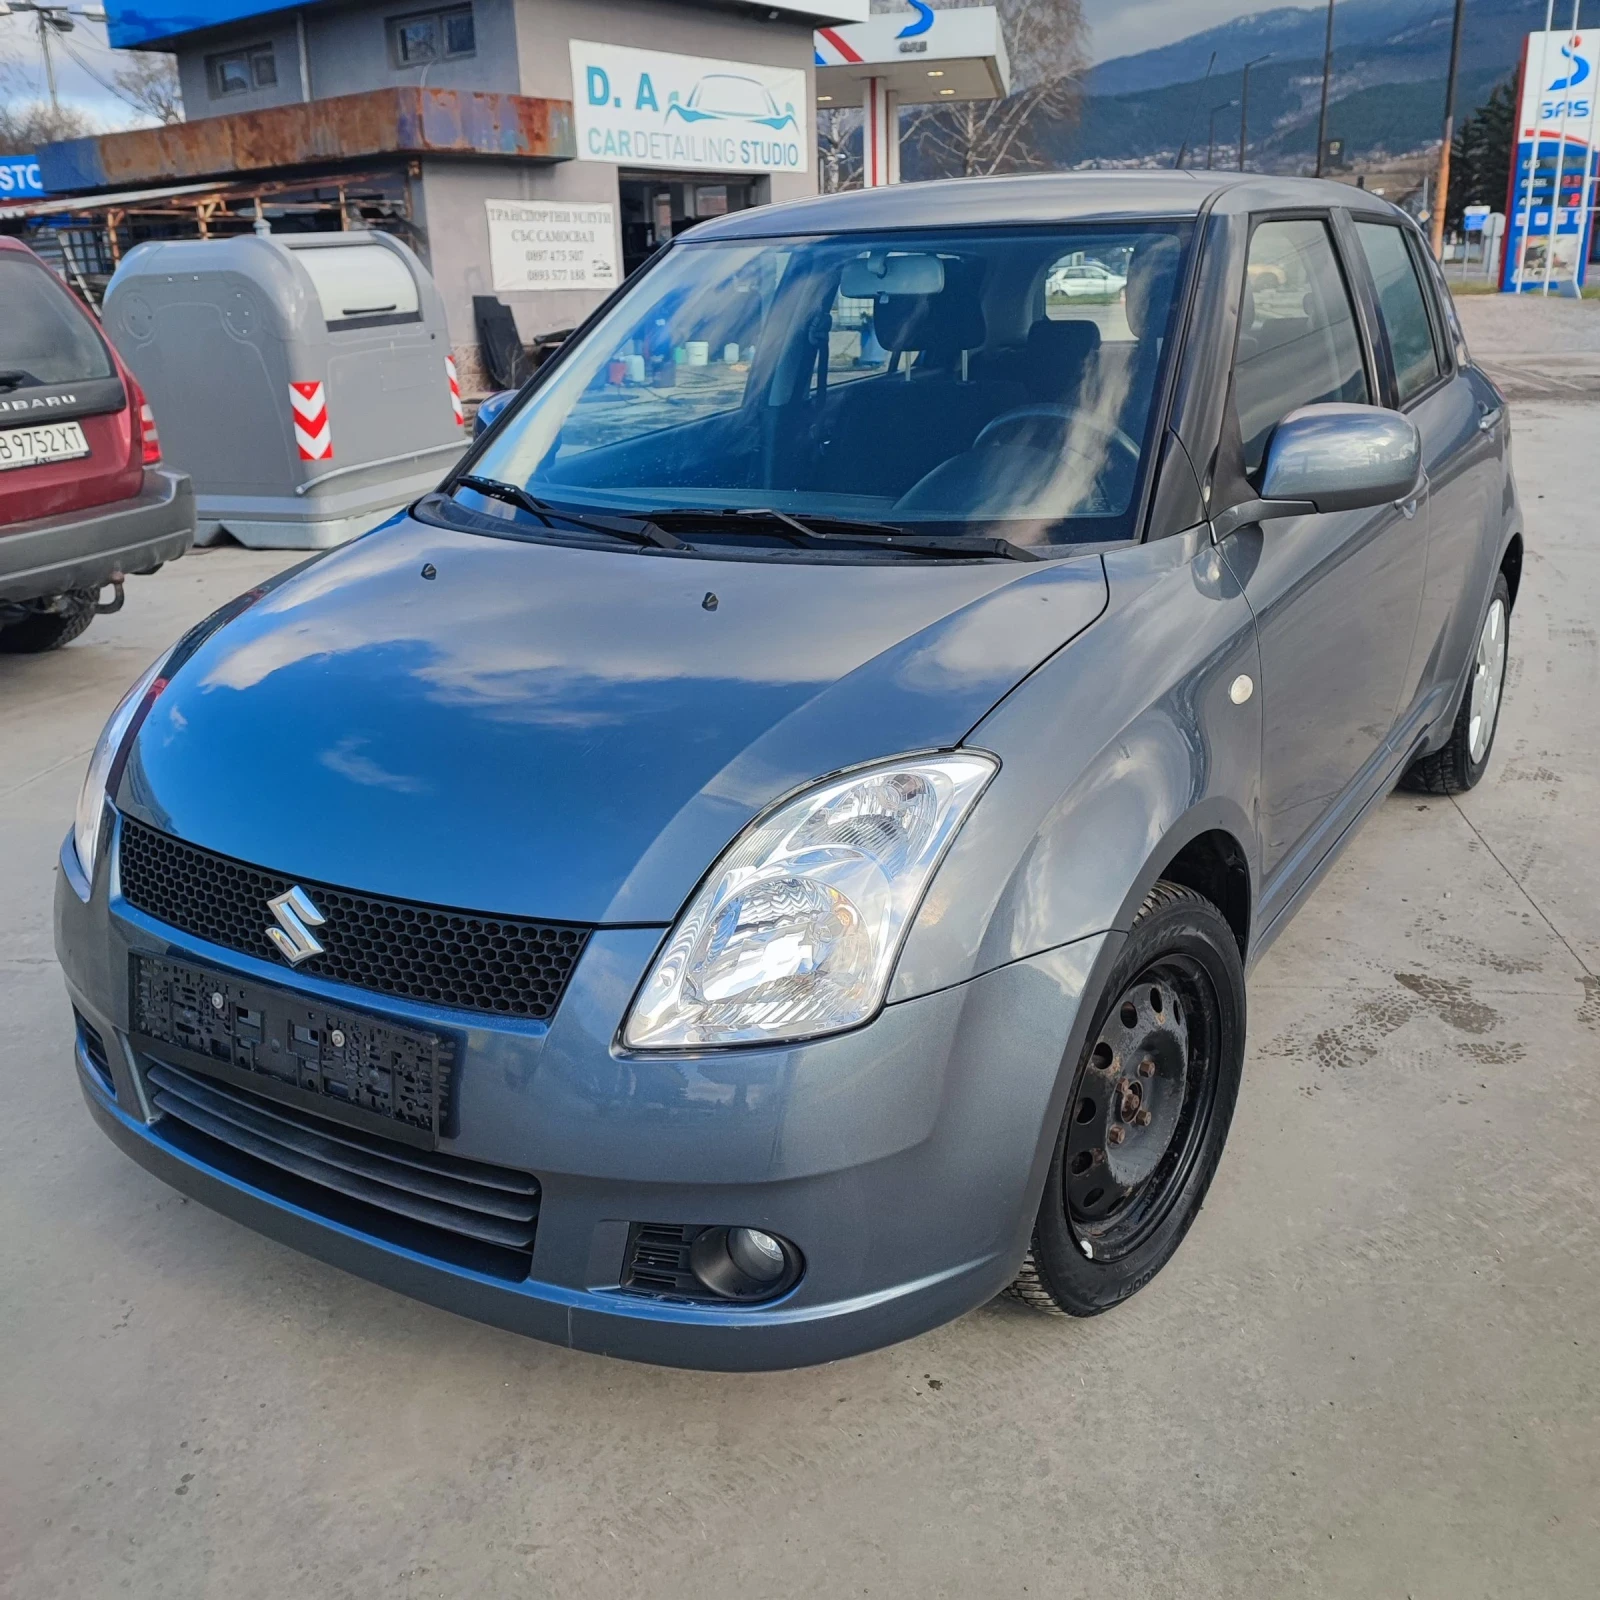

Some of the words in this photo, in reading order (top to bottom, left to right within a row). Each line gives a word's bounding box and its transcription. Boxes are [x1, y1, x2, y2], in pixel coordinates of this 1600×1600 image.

[635, 72, 660, 112] A
[1540, 100, 1590, 119] GAS
[740, 139, 799, 166] STUDIO
